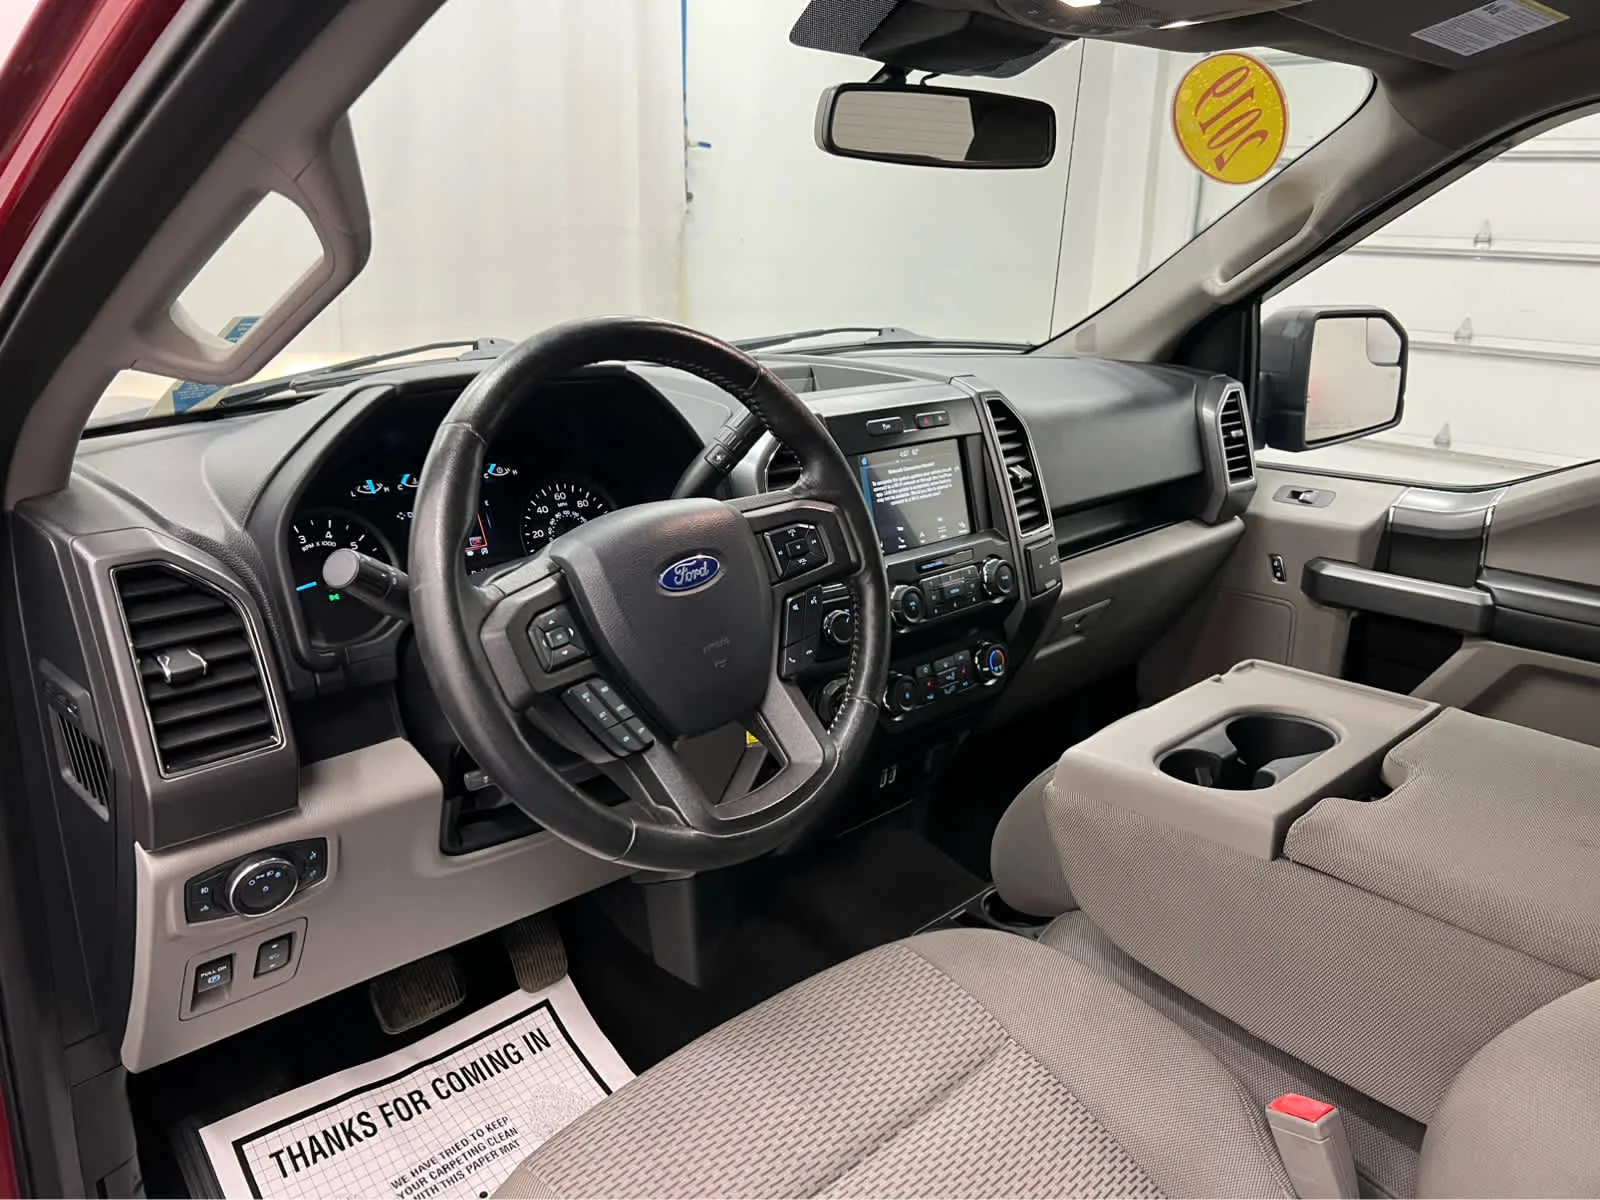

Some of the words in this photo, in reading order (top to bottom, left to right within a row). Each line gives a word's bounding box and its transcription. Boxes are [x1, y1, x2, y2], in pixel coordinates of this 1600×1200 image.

[554, 492, 566, 501] 60
[577, 500, 589, 508] 80
[536, 505, 549, 514] 40
[325, 531, 333, 539] 4
[532, 530, 544, 539] 20
[298, 535, 306, 544] 3
[350, 541, 358, 550] 5
[673, 560, 710, 585] Ford
[269, 1111, 378, 1178] THANKS
[379, 1089, 432, 1129] FOR
[431, 1042, 525, 1101] COMING
[522, 1027, 551, 1055] IN
[391, 1174, 411, 1190] WE
[410, 1156, 439, 1177] HAVE
[439, 1138, 470, 1160] TRIED
[471, 1128, 485, 1141] TO
[485, 1116, 510, 1132] KEEP
[396, 1177, 428, 1199] YOUR
[430, 1143, 487, 1180] CARPETING
[487, 1127, 519, 1147] CLEAN
[440, 1170, 466, 1188] THIS
[466, 1151, 499, 1174] PAPER
[499, 1139, 521, 1155] MAT
